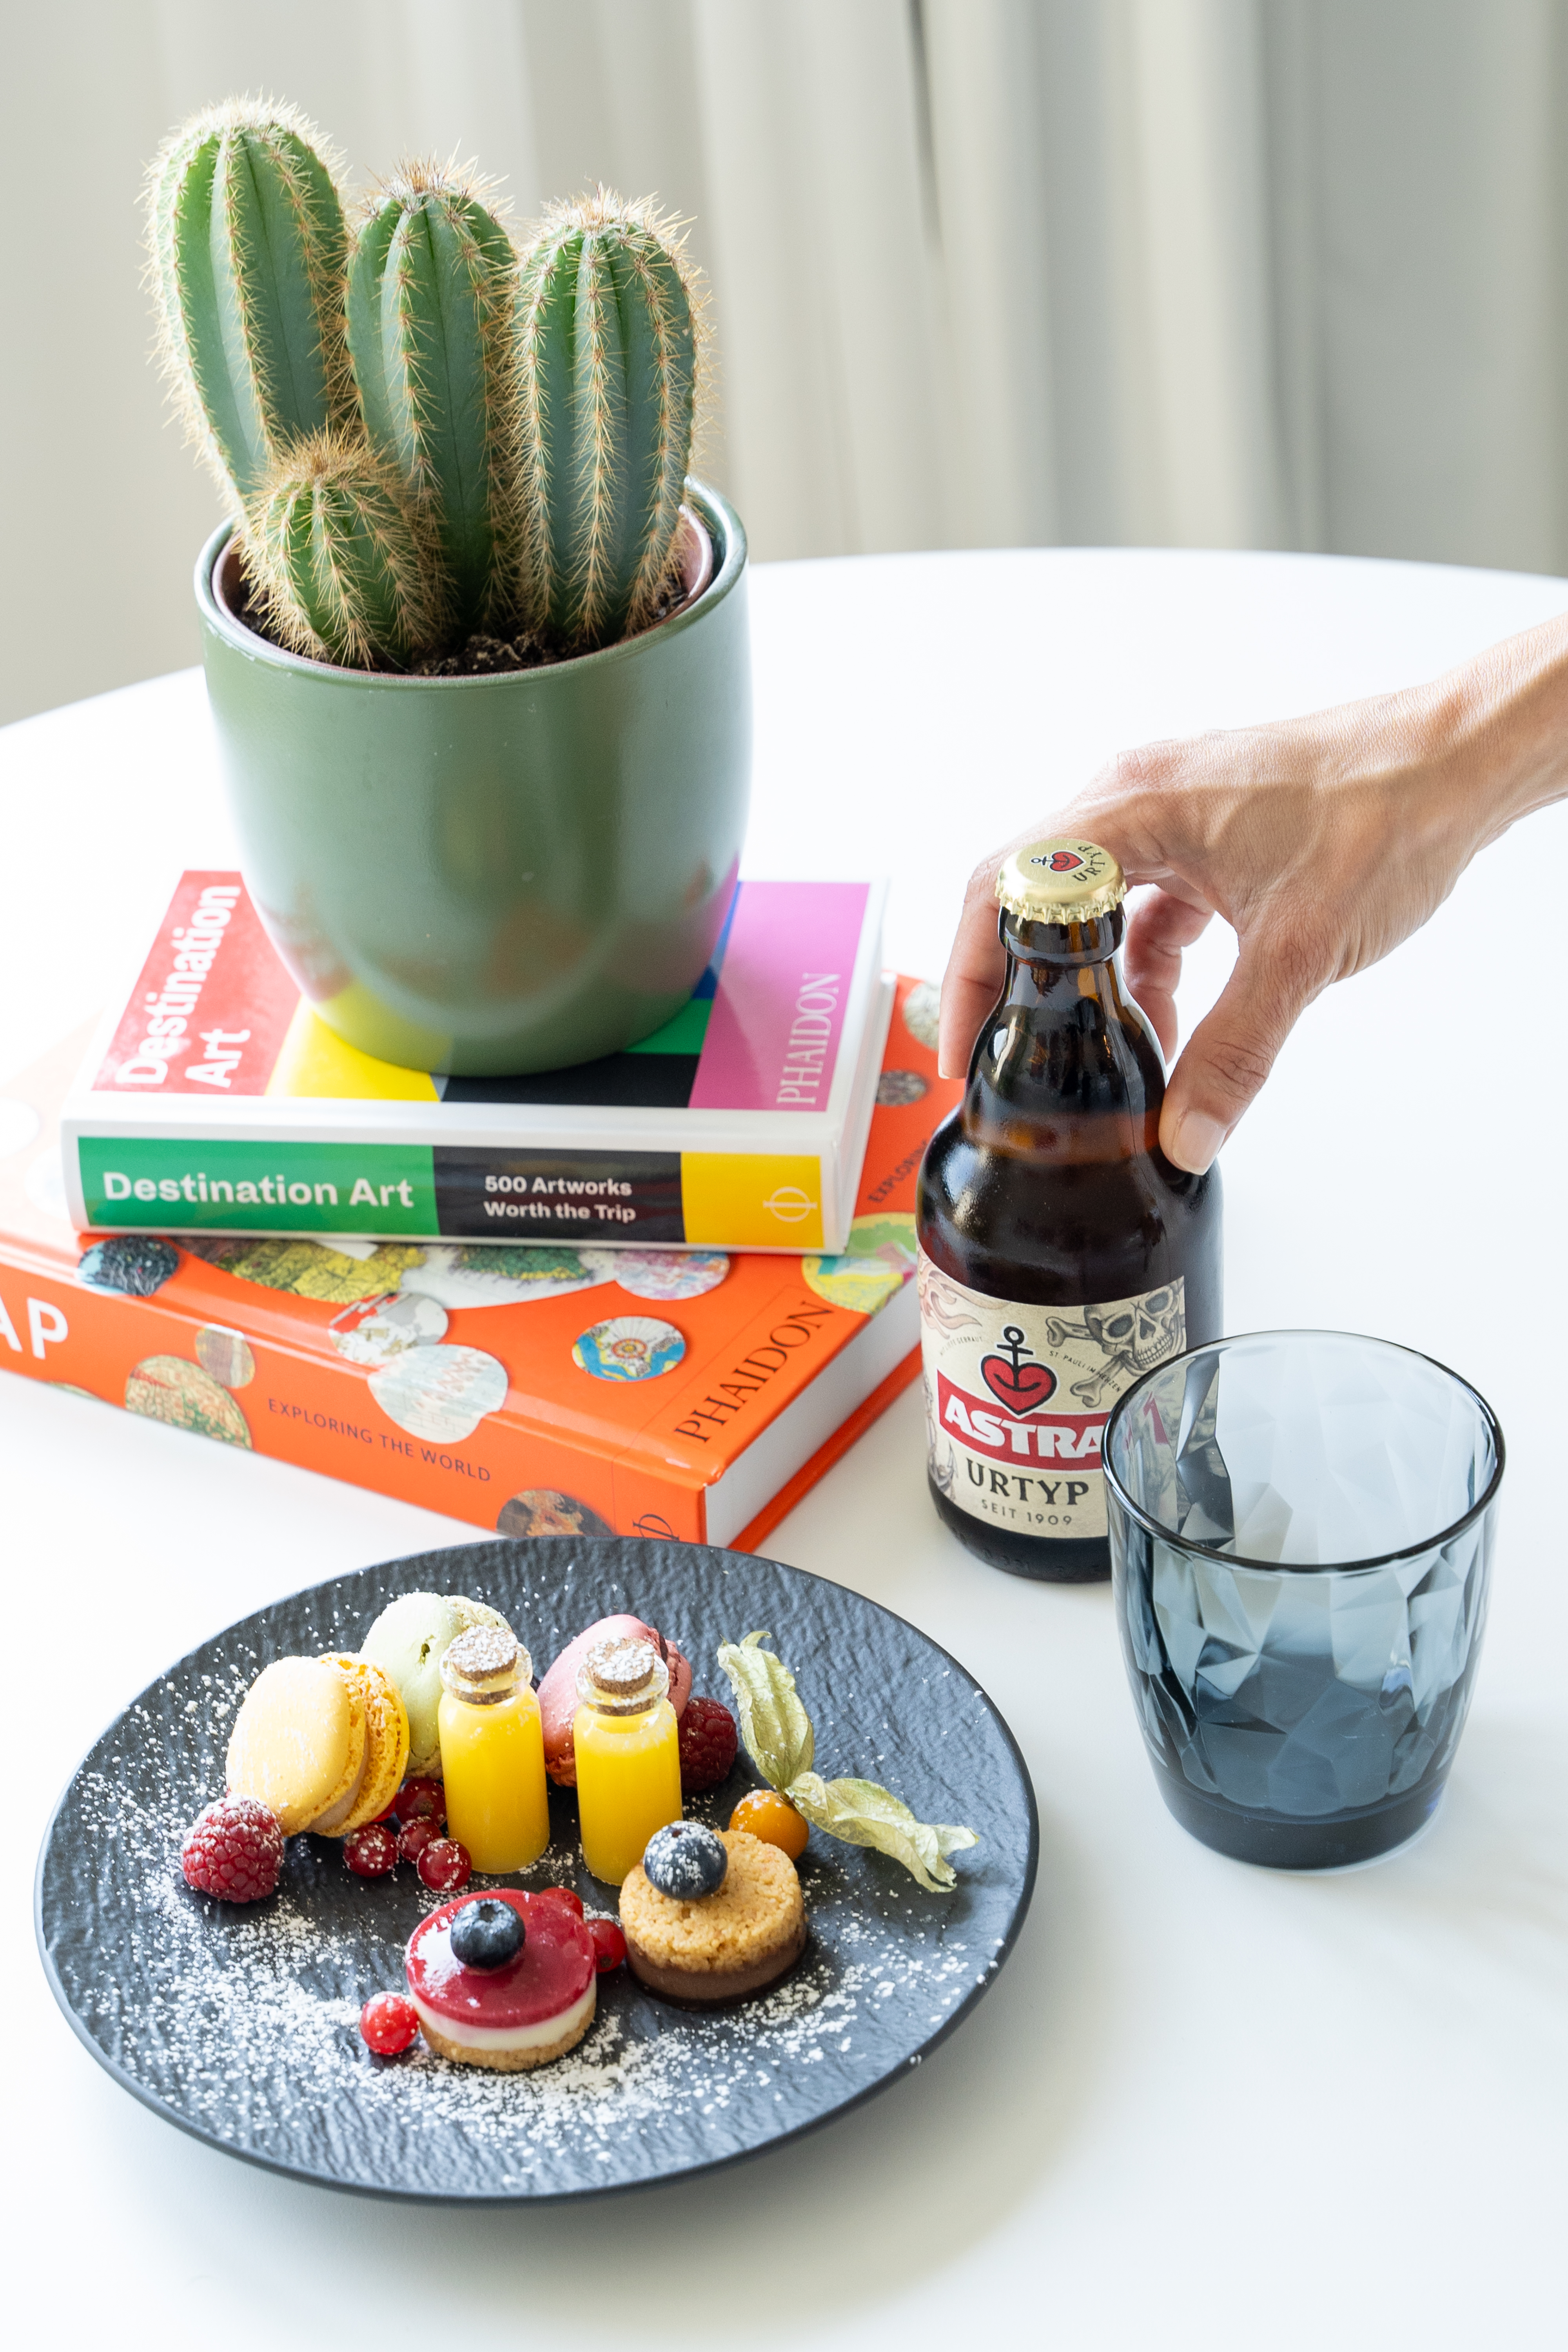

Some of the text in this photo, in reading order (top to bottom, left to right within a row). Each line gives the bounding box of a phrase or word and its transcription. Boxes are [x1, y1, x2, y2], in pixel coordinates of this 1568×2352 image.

[1072, 846, 1105, 881] URTYP
[114, 885, 241, 1085] Destination
[185, 1028, 251, 1088] Art
[776, 972, 841, 1105] PHAIDON
[103, 1171, 414, 1208] Destination Art
[485, 1175, 632, 1196] 500 Artworks
[483, 1201, 636, 1223] Worth the Trip
[674, 1301, 834, 1443] PHAIDON
[1063, 1354, 1085, 1368] PAULI
[1086, 1365, 1096, 1374] IM
[1097, 1372, 1123, 1393] HERZEN
[268, 1398, 491, 1482] EXPLORING THE WORLD
[944, 1394, 1105, 1459] ASTRA
[966, 1457, 1089, 1506] URTYP
[982, 1499, 1072, 1525] SEIT 1909
